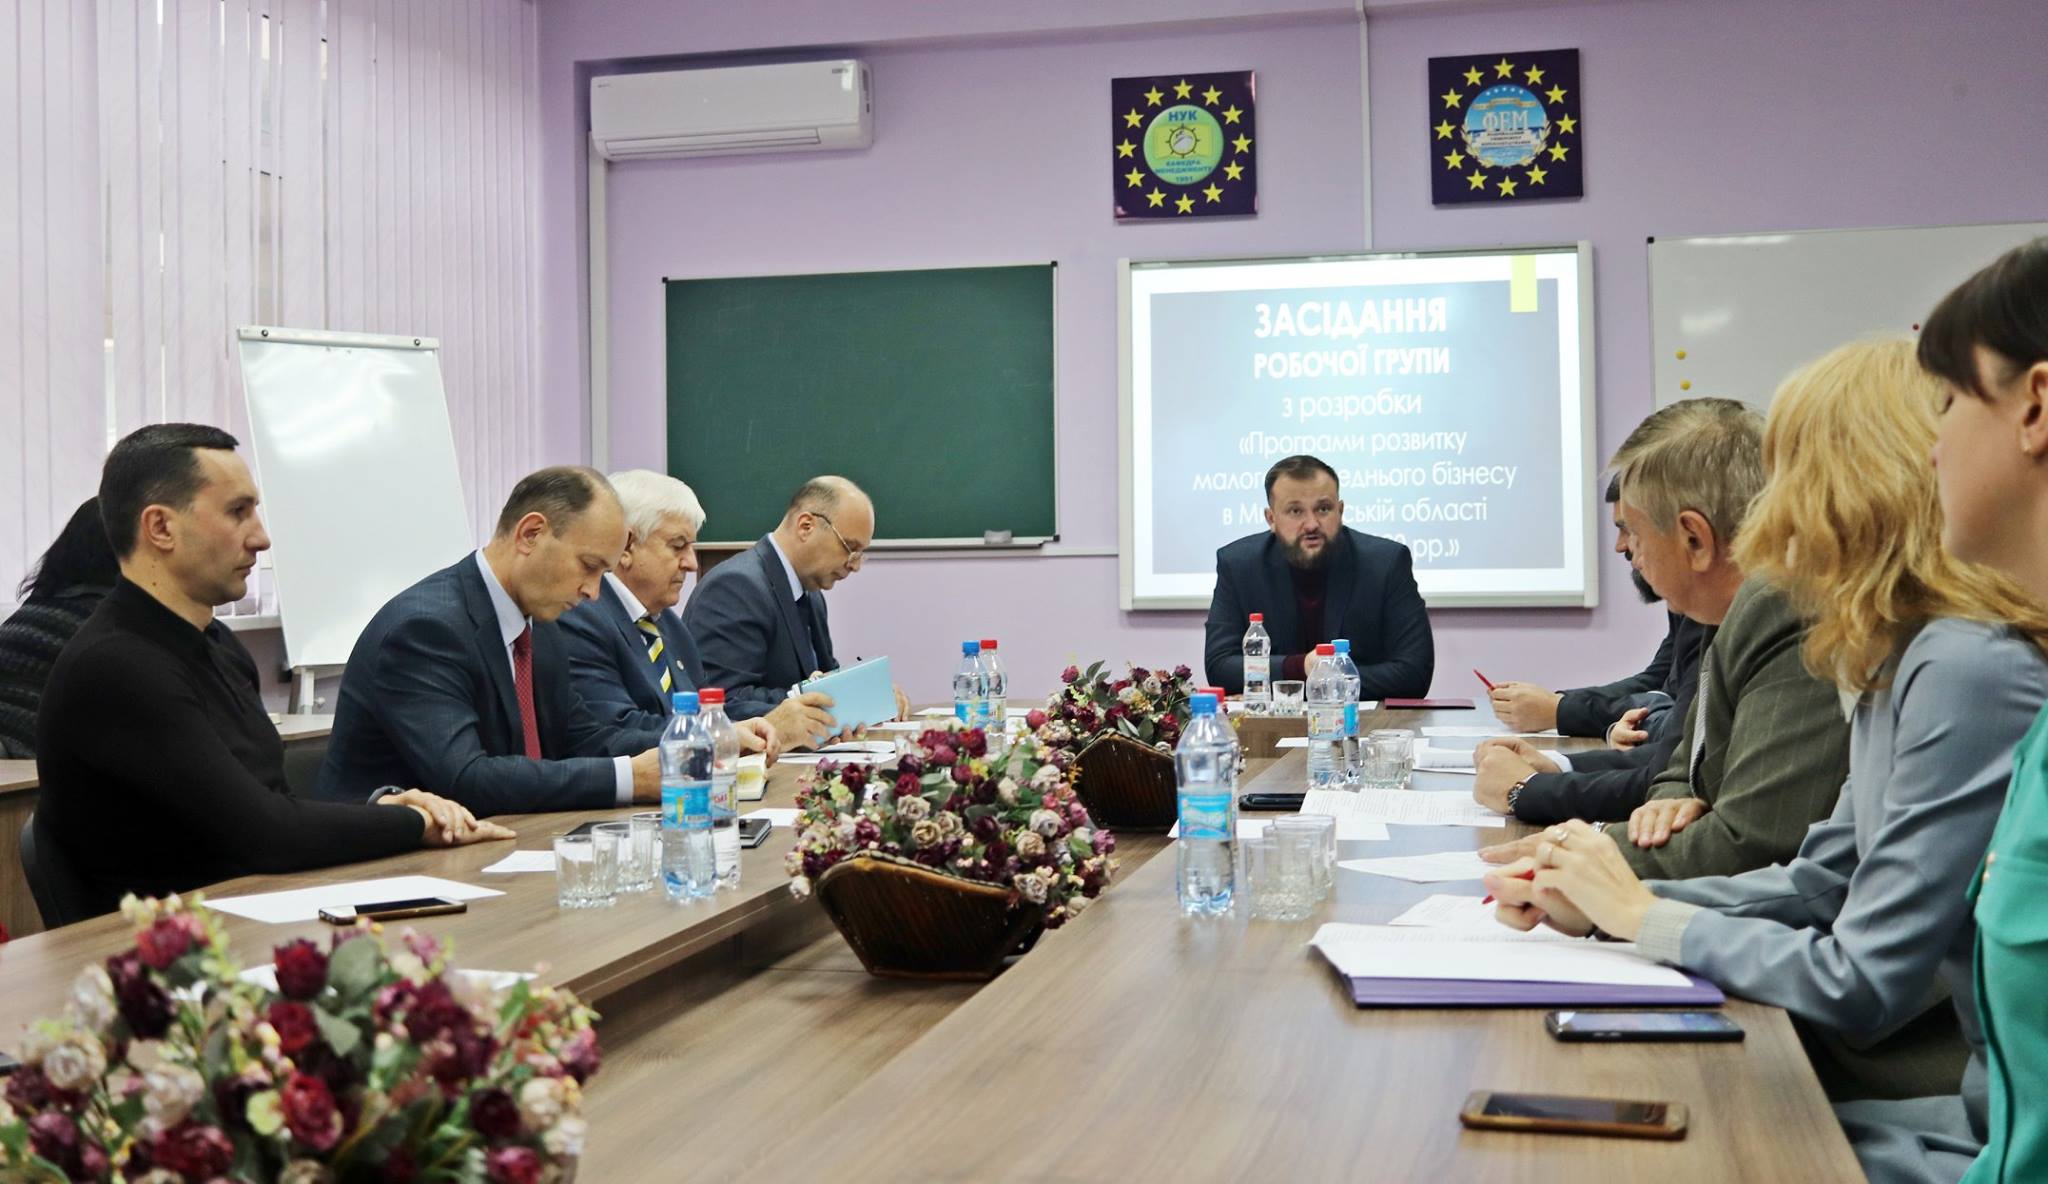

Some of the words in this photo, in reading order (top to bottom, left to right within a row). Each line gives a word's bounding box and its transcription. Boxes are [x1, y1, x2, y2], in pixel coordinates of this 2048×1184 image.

[1168, 110, 1198, 121] НУК
[1482, 110, 1528, 132] ФЕМ
[1254, 297, 1447, 340] ЗАСІДАННЯ
[1254, 343, 1369, 379] РОБОЧОЇ
[1374, 346, 1450, 376] ГРУПИ
[1281, 397, 1293, 418] з
[1299, 387, 1422, 423] розробки
[1238, 431, 1364, 458] «Програми
[1371, 431, 1467, 456] розвитку
[1192, 471, 1267, 491] малог
[1339, 466, 1426, 488] еднього
[1432, 461, 1517, 489] бізнесу
[1221, 507, 1233, 525] в
[1401, 496, 1488, 523] області
